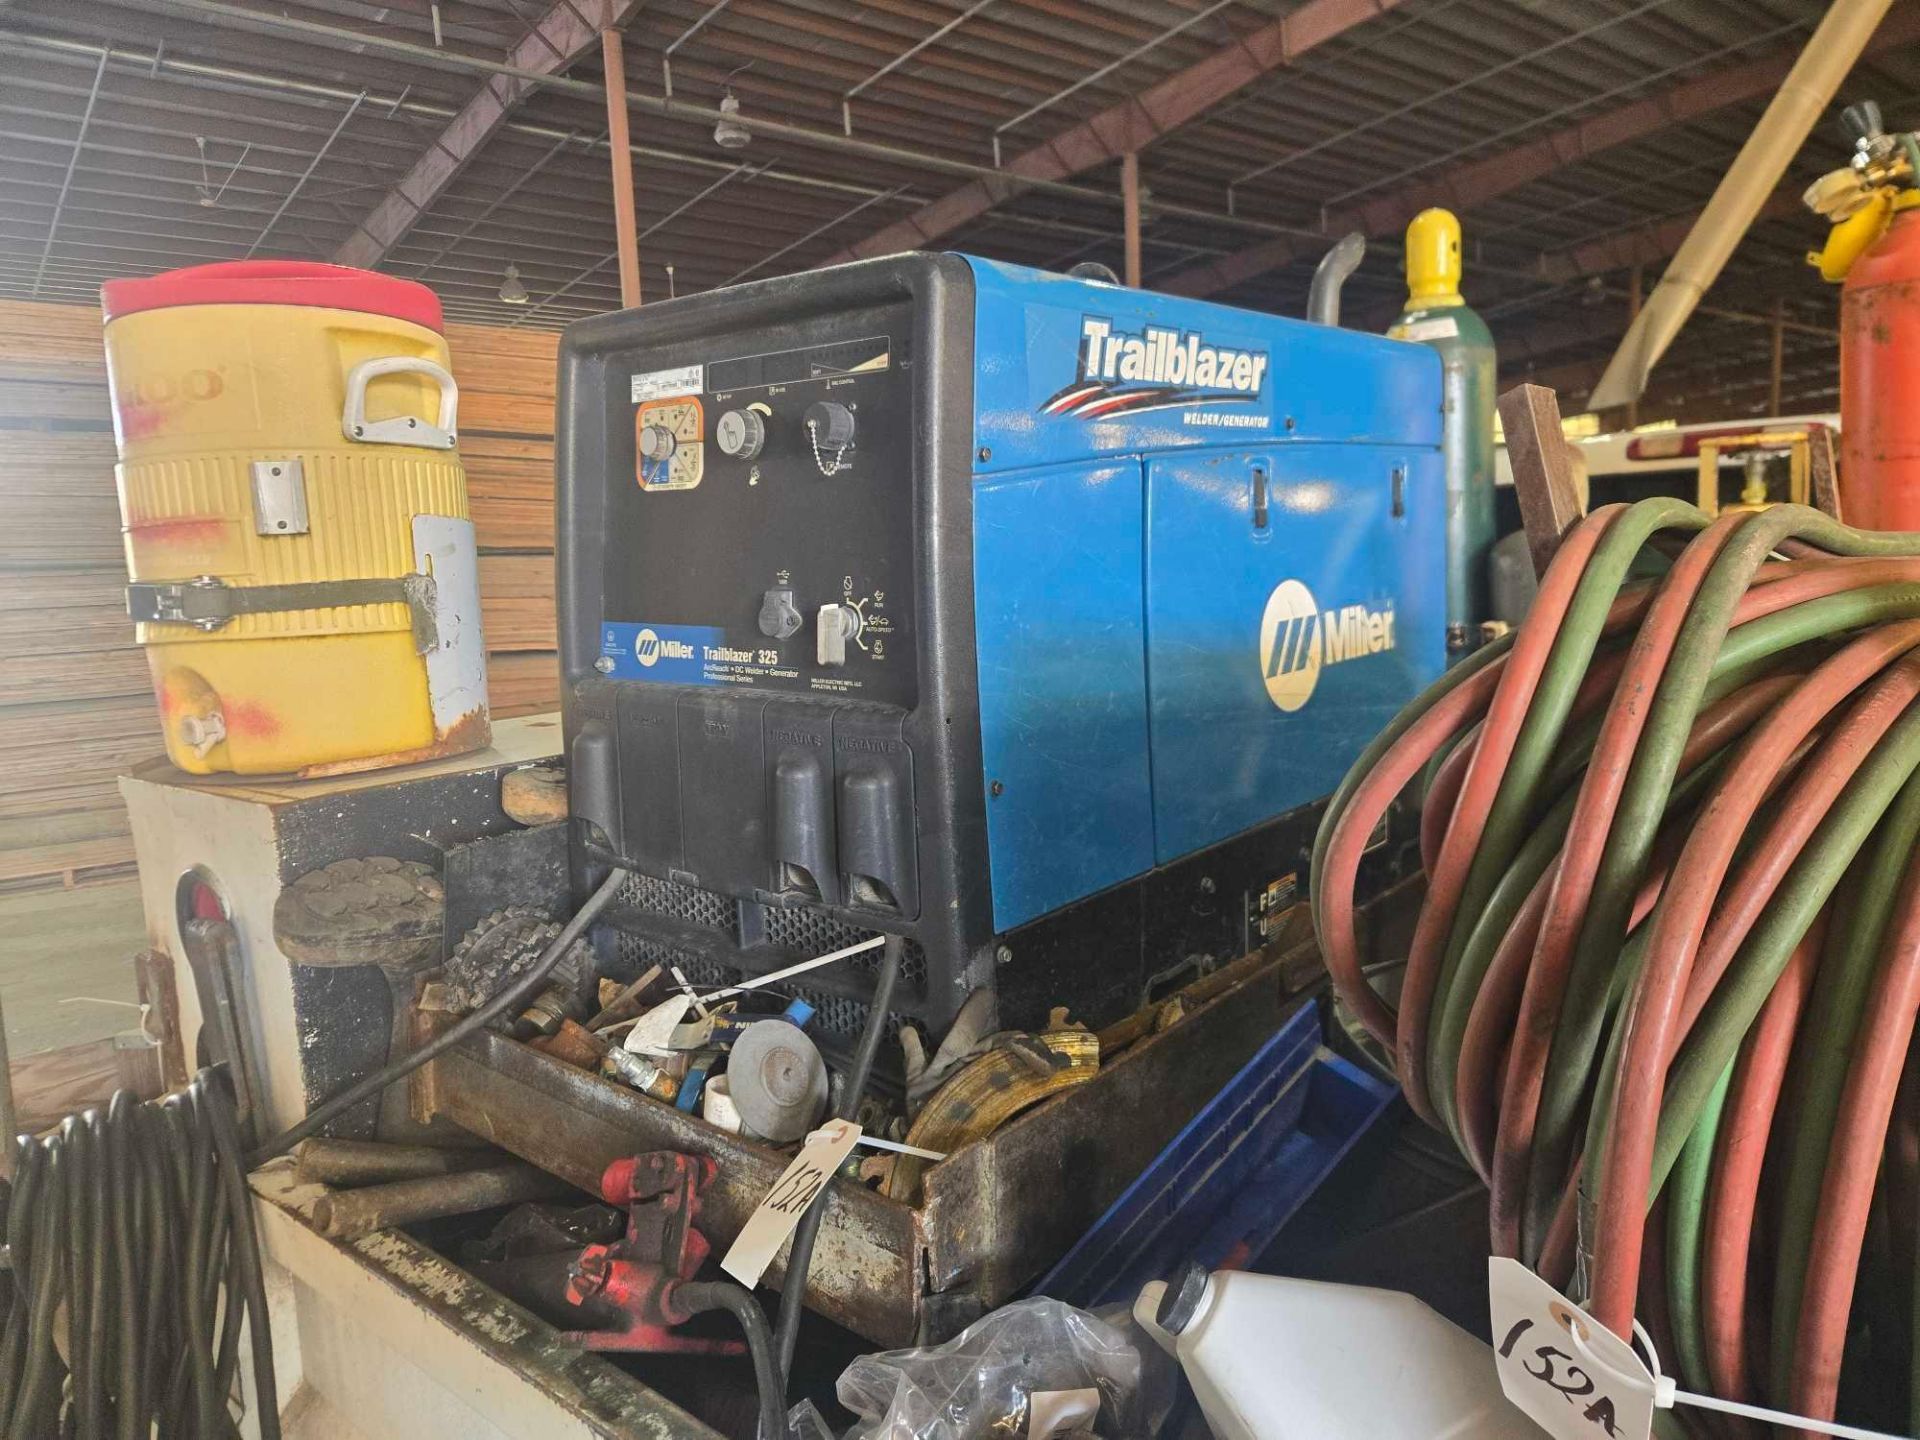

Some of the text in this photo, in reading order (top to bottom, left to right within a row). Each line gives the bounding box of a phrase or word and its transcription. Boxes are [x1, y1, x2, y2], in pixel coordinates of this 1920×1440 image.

[1083, 319, 1267, 393] Trailblazer
[1183, 412, 1269, 428] WELDER/GENERATOR
[1324, 604, 1395, 665] Miller
[660, 640, 694, 660] Miller
[703, 646, 778, 665] Trailblazer 325
[703, 671, 754, 684] Professional Series
[769, 668, 799, 679] Generator
[762, 1159, 823, 1214] 152A
[1498, 1318, 1626, 1439] 152A
